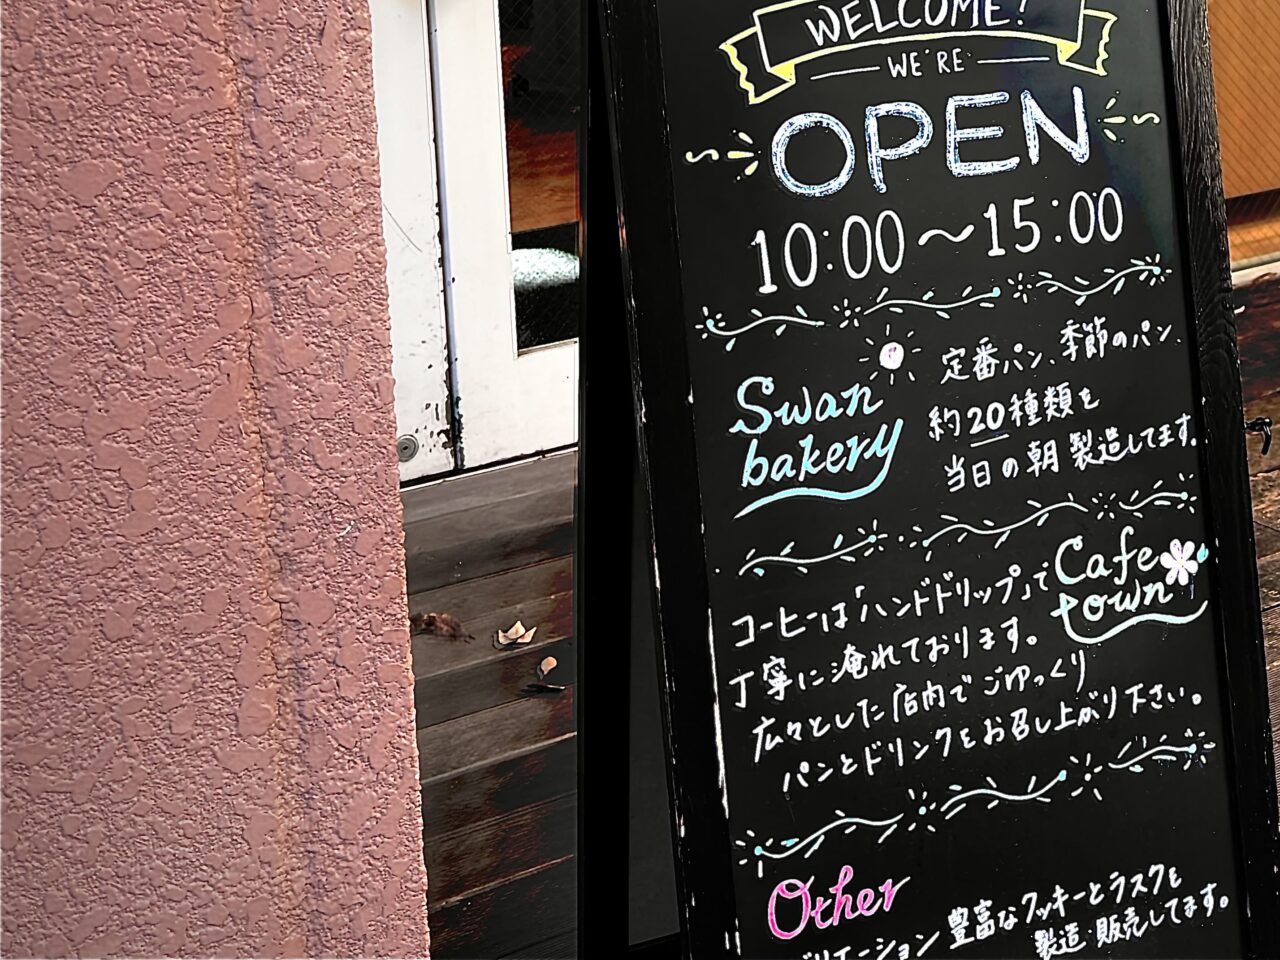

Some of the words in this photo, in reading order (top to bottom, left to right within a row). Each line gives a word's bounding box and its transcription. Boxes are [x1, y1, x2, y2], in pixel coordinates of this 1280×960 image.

[771, 86, 1091, 198] OPEN
[728, 376, 884, 435] Swan
[928, 381, 1101, 444] 約20種類を
[734, 417, 904, 506] bakery
[1055, 525, 1160, 586] Cafe
[1050, 578, 1188, 633] town
[767, 863, 911, 940] Other
